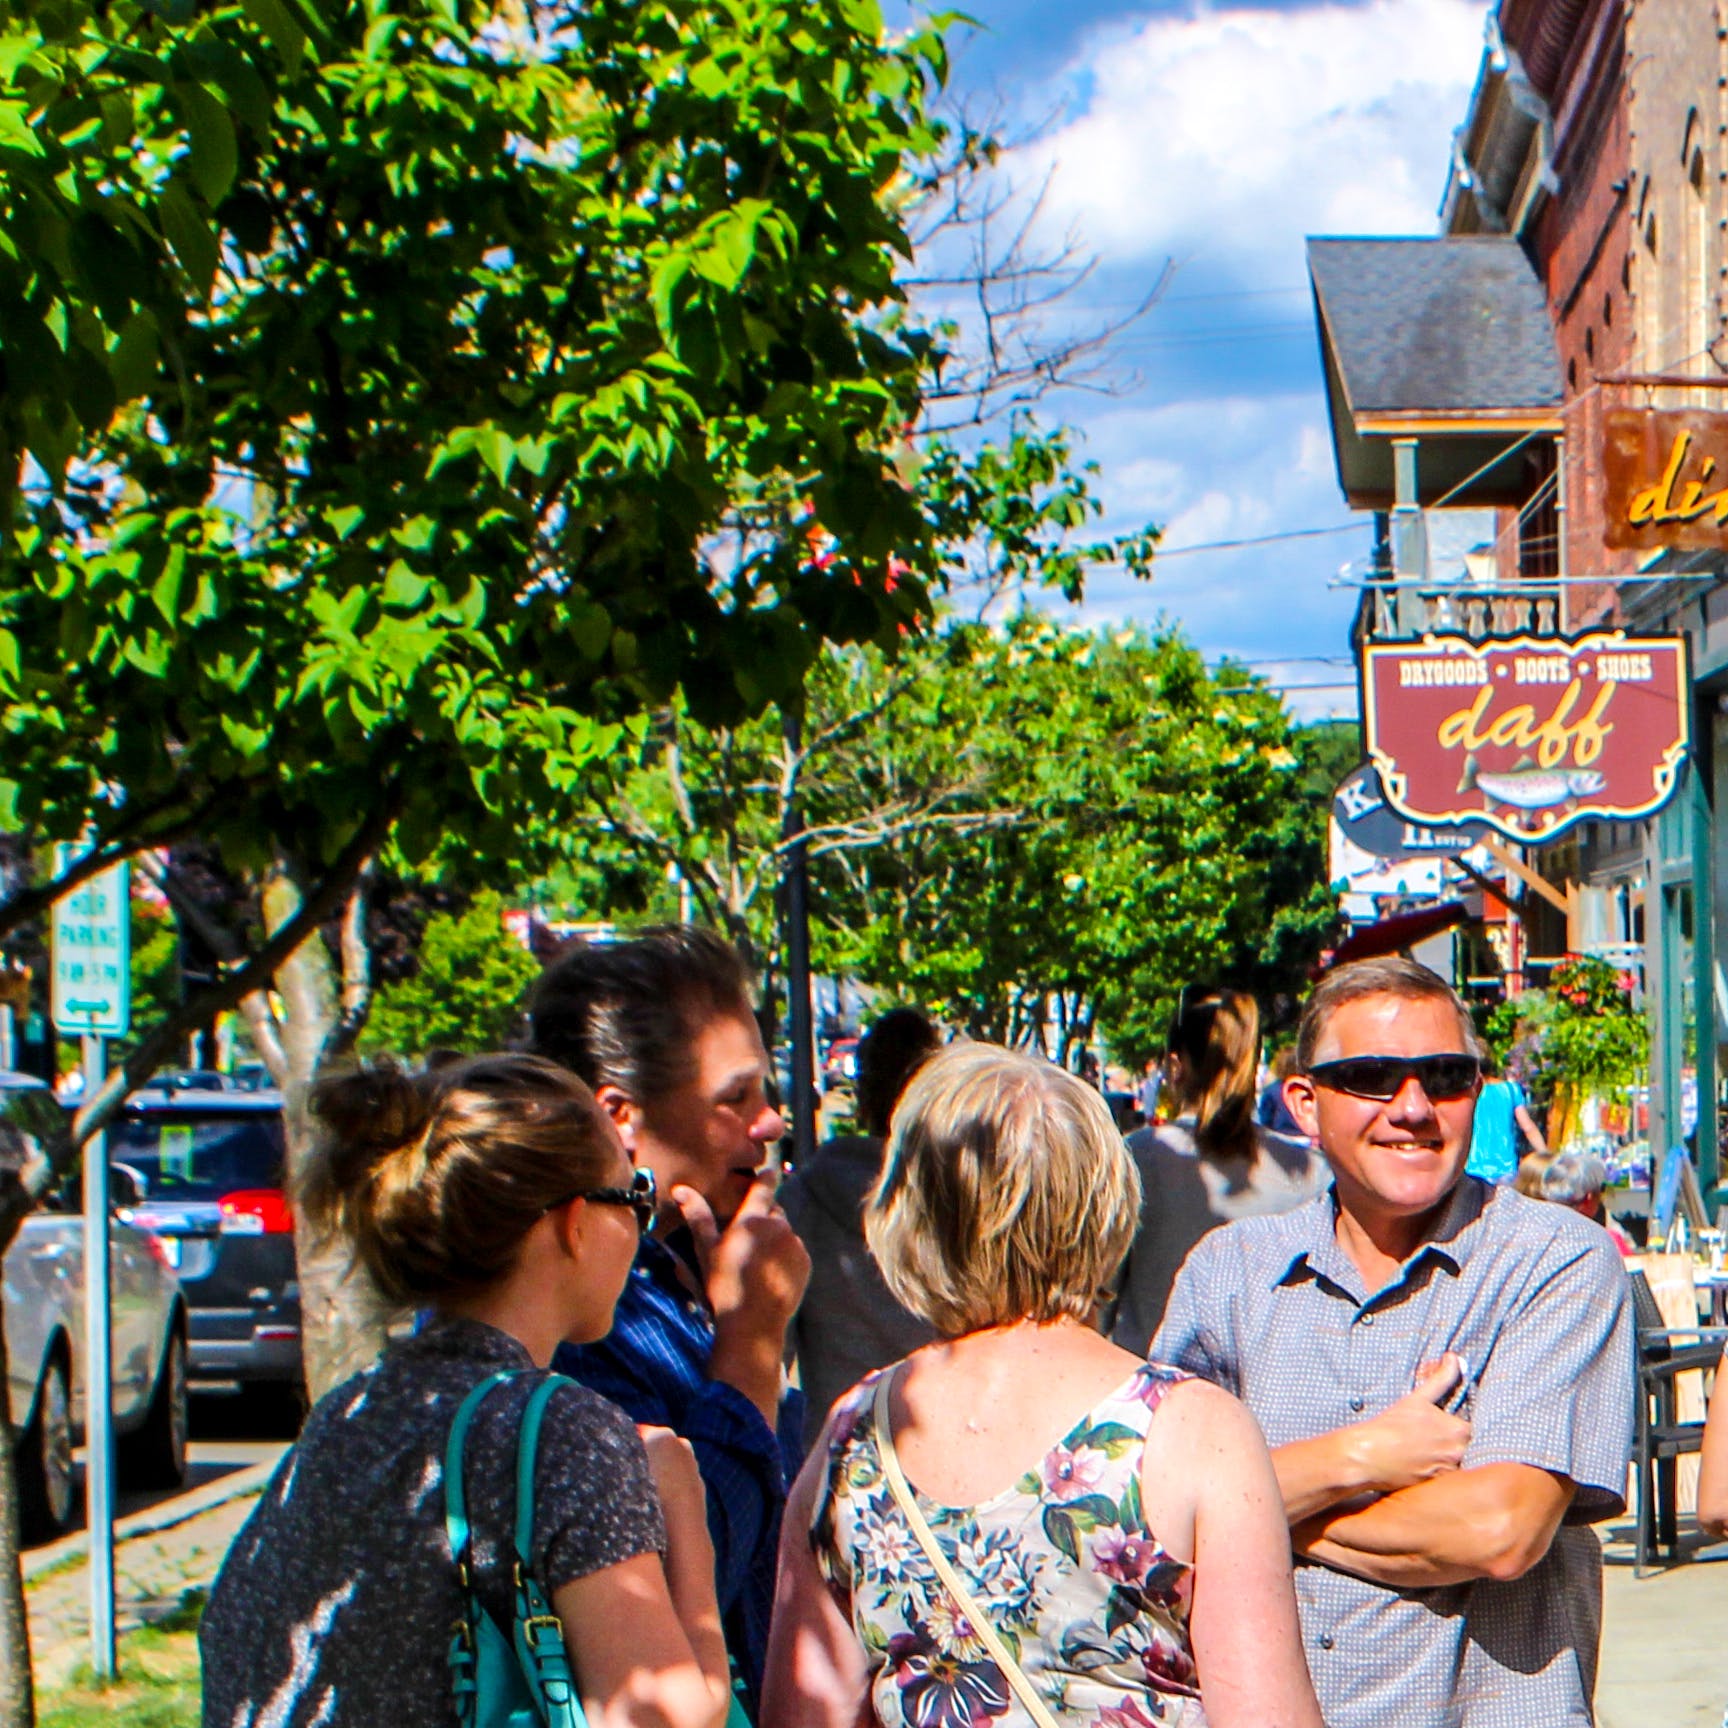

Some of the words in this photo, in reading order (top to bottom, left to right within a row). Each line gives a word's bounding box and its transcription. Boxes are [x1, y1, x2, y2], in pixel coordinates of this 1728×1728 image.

[1400, 658, 1489, 687] DRYGOODS
[1514, 656, 1571, 684] BOOTS
[1596, 653, 1653, 682] SHOES
[1437, 677, 1616, 769] daff
